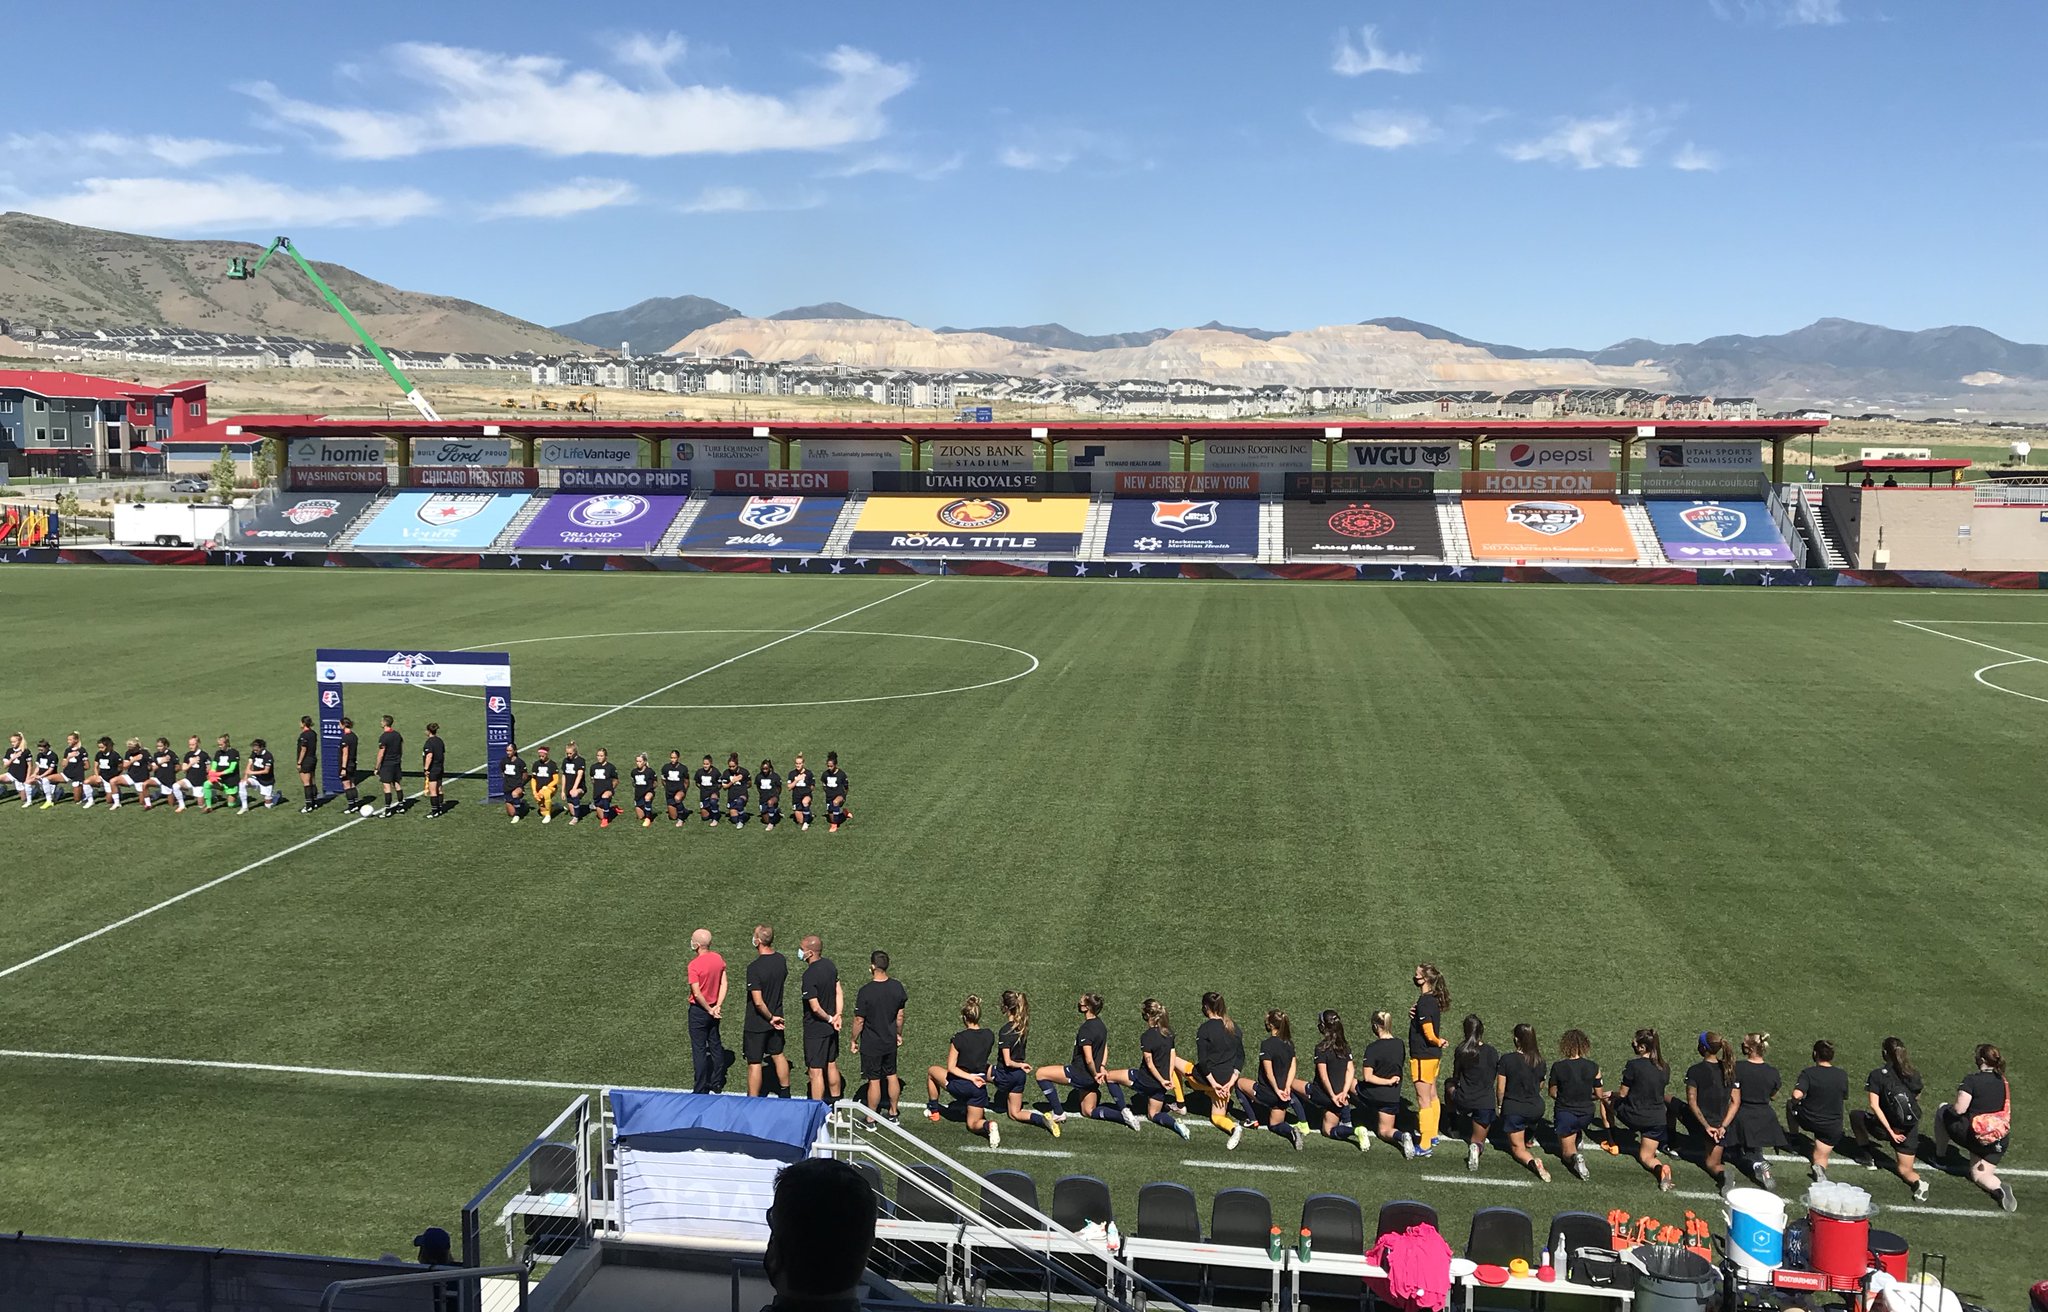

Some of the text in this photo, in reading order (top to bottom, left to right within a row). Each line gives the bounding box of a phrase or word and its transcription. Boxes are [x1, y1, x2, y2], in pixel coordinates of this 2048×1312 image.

[320, 444, 379, 462] homie
[436, 443, 484, 463] Ford
[563, 448, 630, 461] LifeVantage
[940, 445, 1025, 457] ZIONS BANK
[1209, 444, 1246, 454] COLLINS
[1247, 444, 1288, 454] ROOFING
[1354, 446, 1416, 465] WGU
[956, 459, 1010, 467] STADIUM
[1539, 447, 1593, 466] pepsi
[1686, 456, 1752, 464] COMMISSION
[297, 470, 382, 482] WASHINGTON DC
[422, 470, 525, 485] CHICAGO RED STARS
[563, 471, 688, 487] ORLANDO PRIDE
[735, 472, 829, 488] OL REIGN
[925, 475, 1037, 489] UTAH ROYALS FC
[1296, 476, 1424, 489] PORTLAND
[1486, 475, 1592, 490] HOUSTON
[1124, 476, 1146, 489] NEW
[1149, 476, 1188, 490] JERSEY
[1196, 476, 1220, 489] NEW
[1223, 476, 1250, 489] YORK
[1643, 479, 1759, 488] NORTH CAROLINA COURAGE
[589, 494, 641, 505] ORLANDO
[1506, 513, 1585, 523] DASH
[725, 533, 783, 547] zulily
[890, 536, 1037, 548] ROYAL TITLE
[1702, 546, 1774, 556] aetna
[381, 670, 424, 678] CHALLENGE
[1778, 1274, 1819, 1286] BODYARMOR
